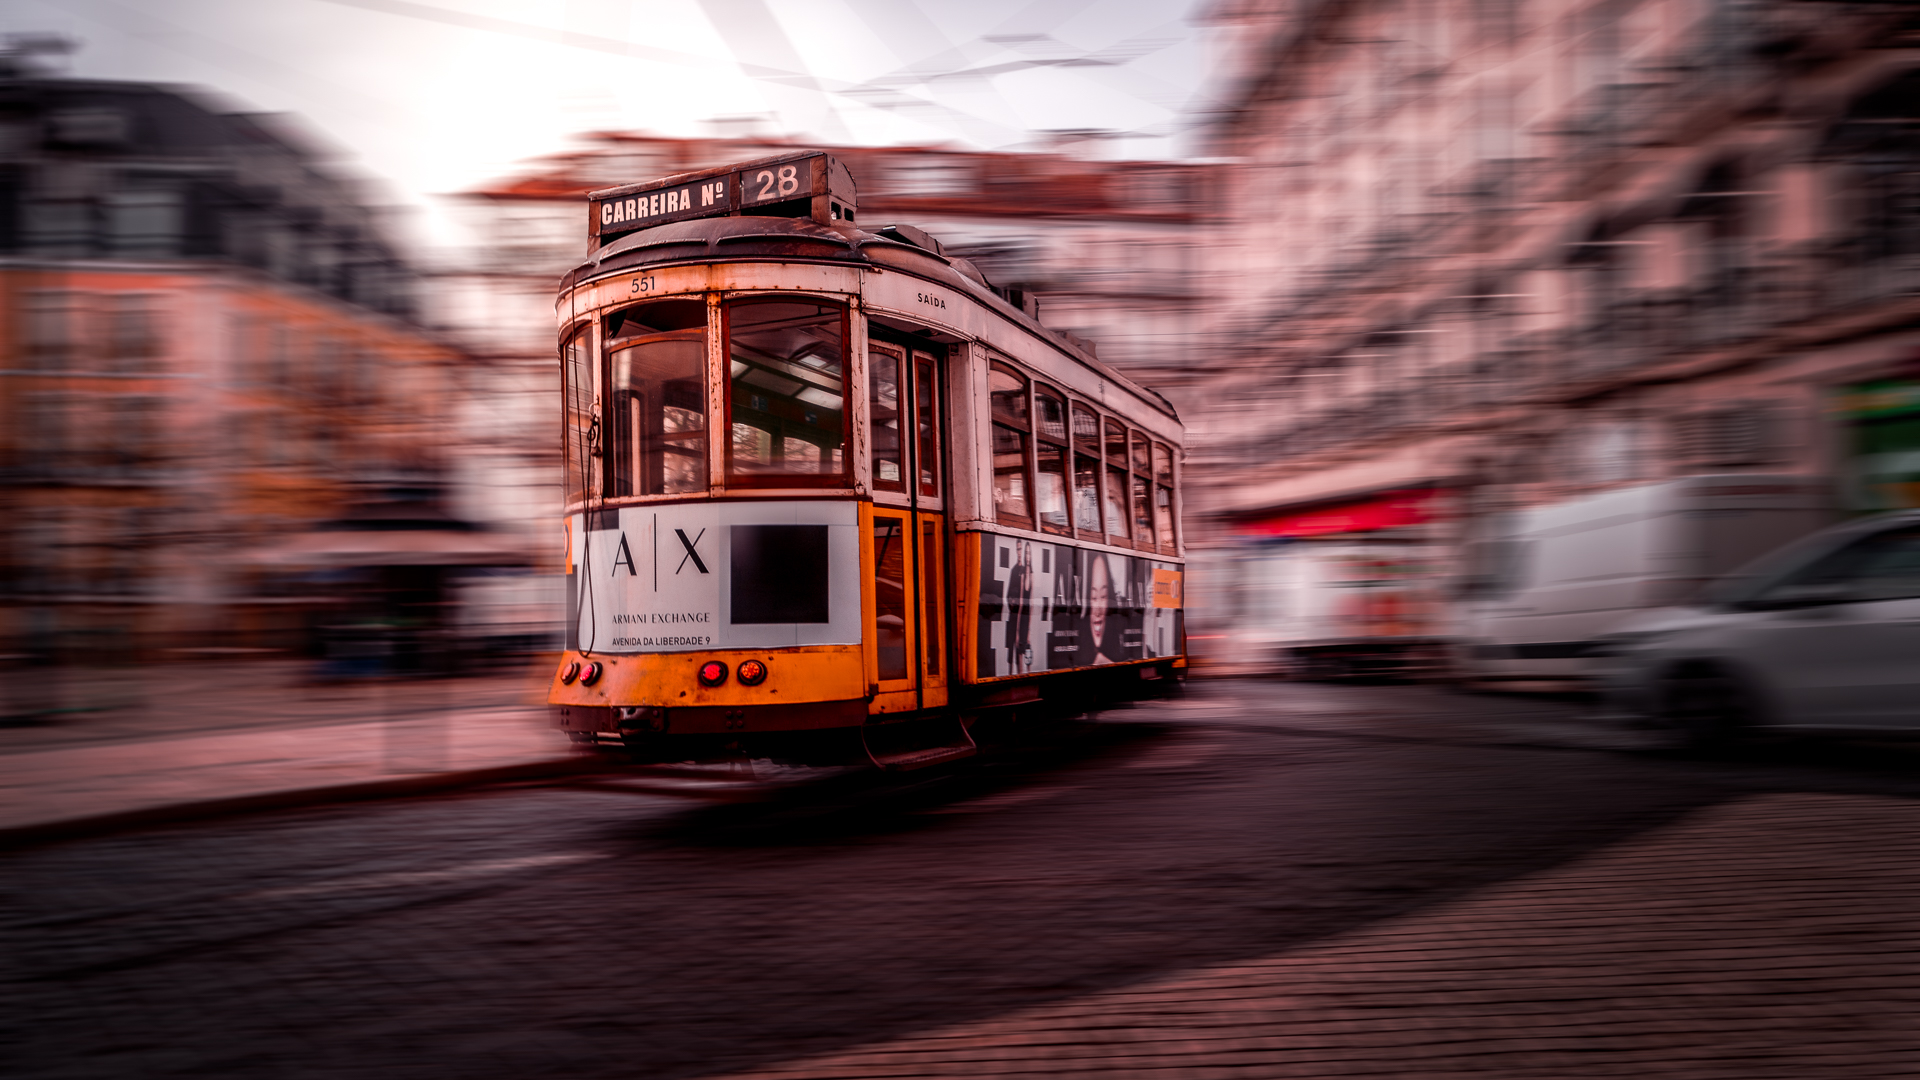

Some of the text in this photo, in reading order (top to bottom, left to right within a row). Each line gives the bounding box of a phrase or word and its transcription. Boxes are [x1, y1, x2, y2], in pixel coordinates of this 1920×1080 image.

[601, 188, 691, 225] CARREIRA
[756, 164, 799, 201] 28
[631, 276, 655, 294] 551
[917, 292, 946, 310] SAÍDA
[612, 612, 710, 625] ARMANI EXCHANGE
[612, 636, 711, 647] AVENIDA DA LIBERDADE 9
